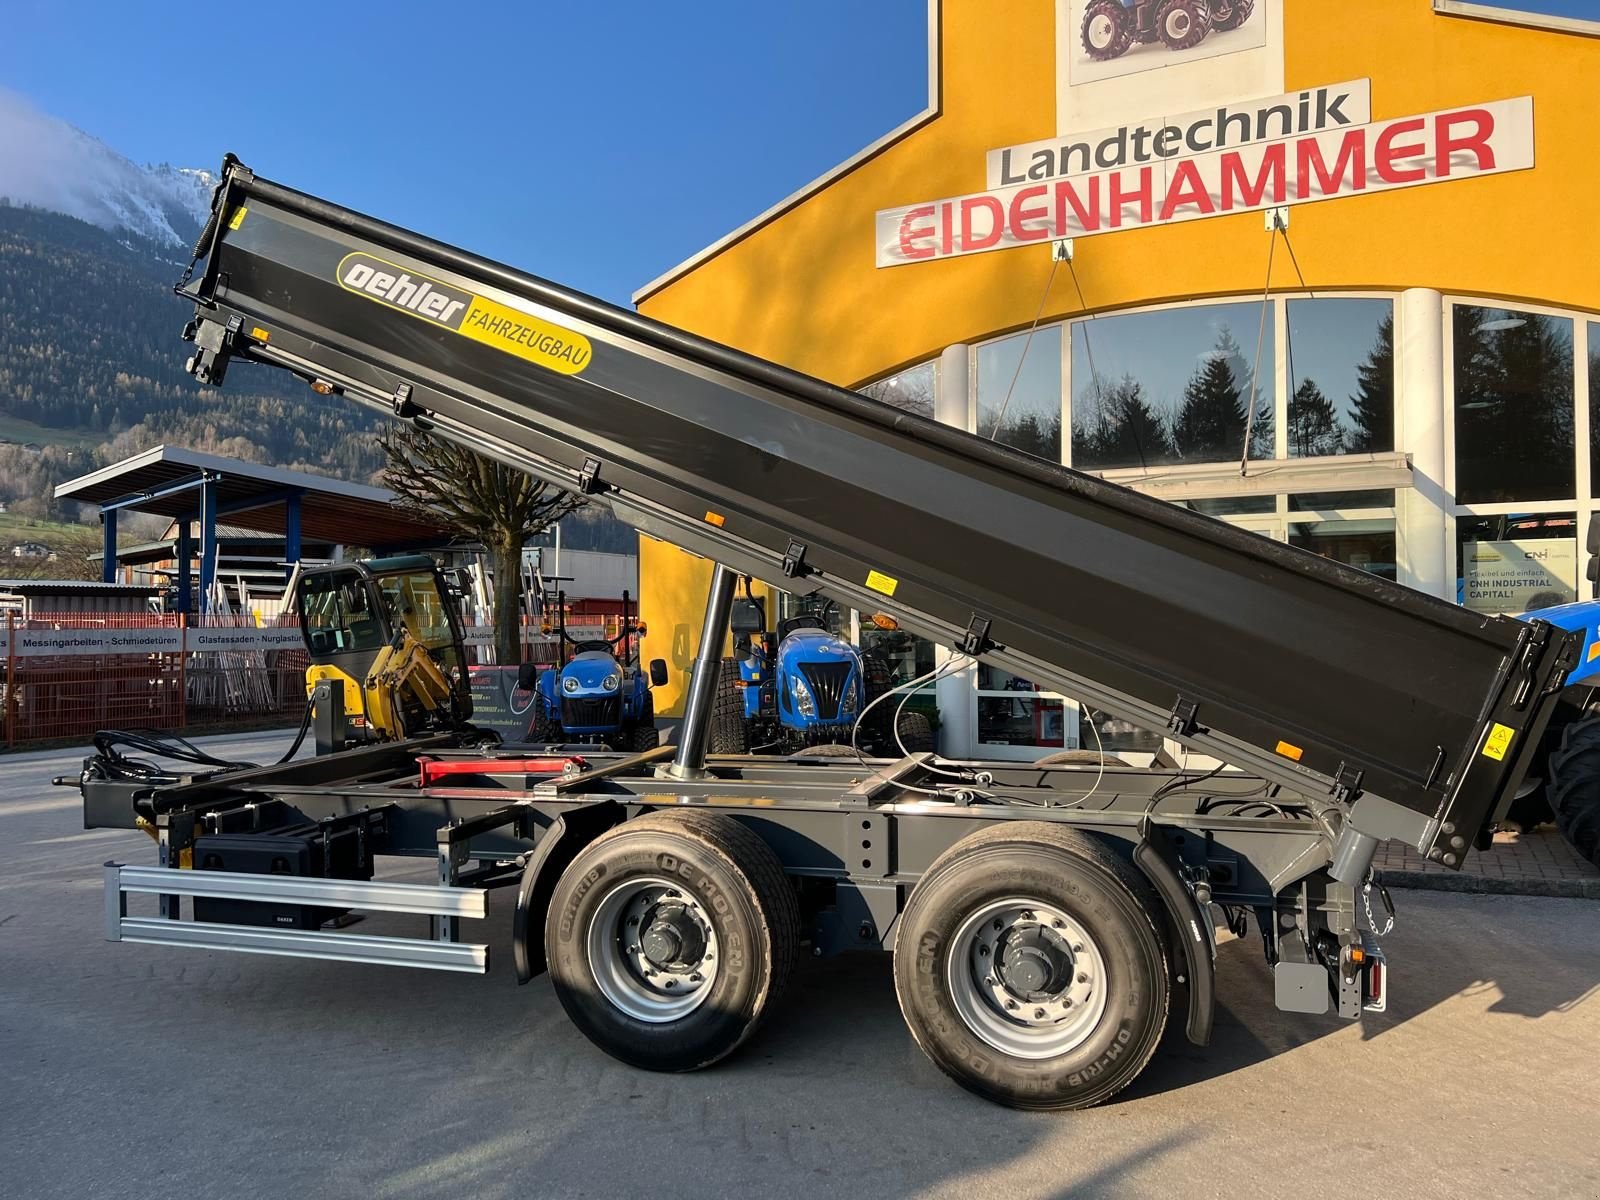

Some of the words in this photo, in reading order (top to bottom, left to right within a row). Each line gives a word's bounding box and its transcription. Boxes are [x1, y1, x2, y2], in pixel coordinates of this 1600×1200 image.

[1000, 88, 1354, 186] Landtechnik
[900, 107, 1497, 260] EIDENHAMMER
[343, 263, 465, 322] oehler
[466, 308, 589, 366] FAHRZEUGBAU
[1469, 580, 1490, 588] CNH
[1492, 579, 1552, 588] INDUSTRIAL
[1500, 569, 1515, 577] und
[1516, 569, 1545, 577] einfach
[1469, 590, 1514, 599] CAPITAL!
[23, 637, 103, 649] Messingarbeiten
[111, 637, 177, 646] Schmiedetüren
[198, 635, 255, 644] Glasfassaden
[660, 855, 694, 880] DE
[697, 876, 743, 968] MOLEN
[1067, 1028, 1132, 1088] DM-RIB
